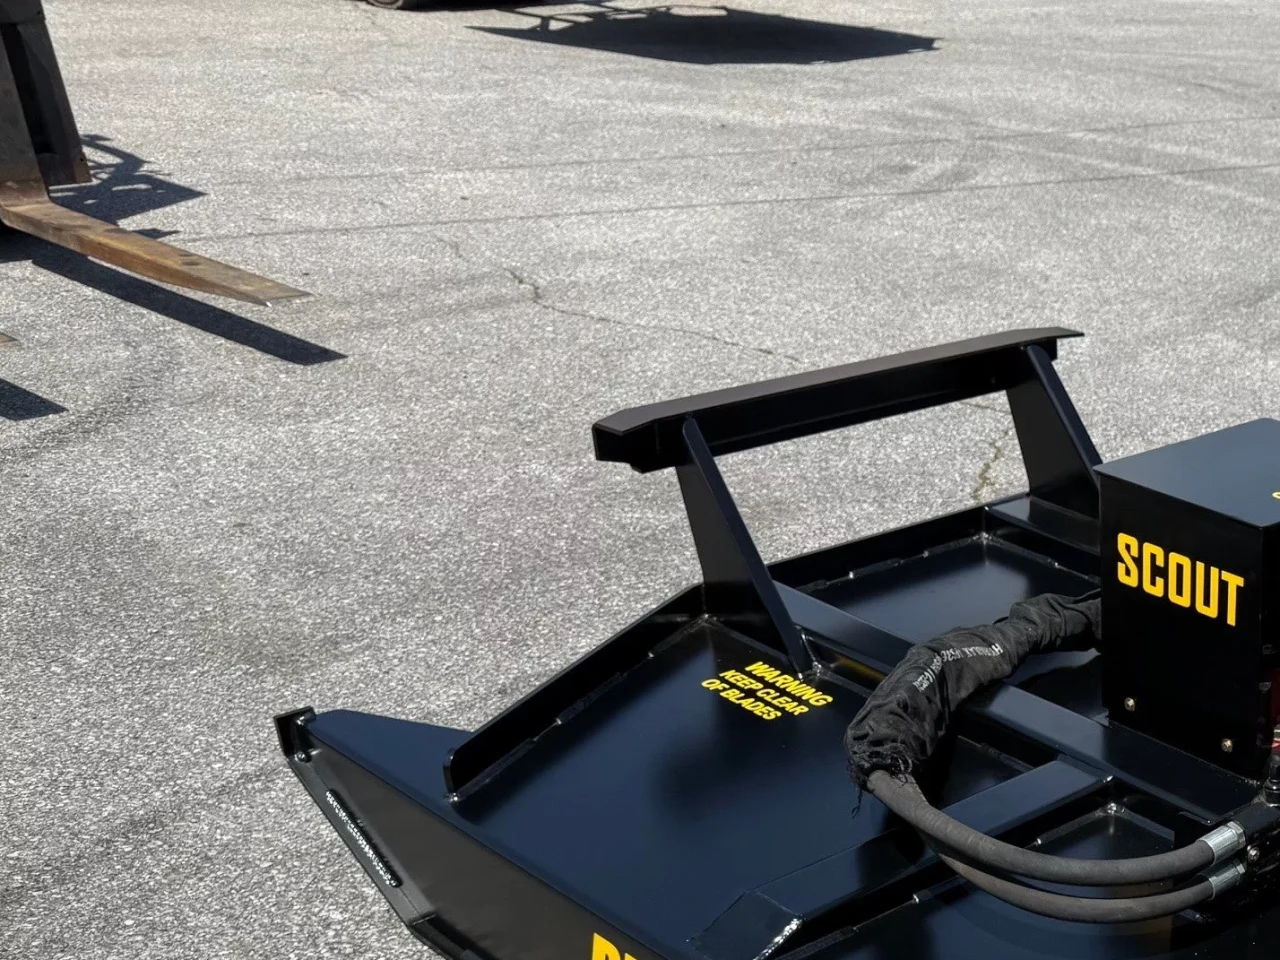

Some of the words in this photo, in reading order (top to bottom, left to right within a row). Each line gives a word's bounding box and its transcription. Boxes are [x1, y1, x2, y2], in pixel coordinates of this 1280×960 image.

[1117, 532, 1244, 627] SCOUT
[701, 678, 730, 690] OF
[720, 688, 782, 721] BLADES
[719, 669, 764, 690] KEEP
[756, 688, 810, 716] CLEAR
[745, 661, 834, 707] WARNING
